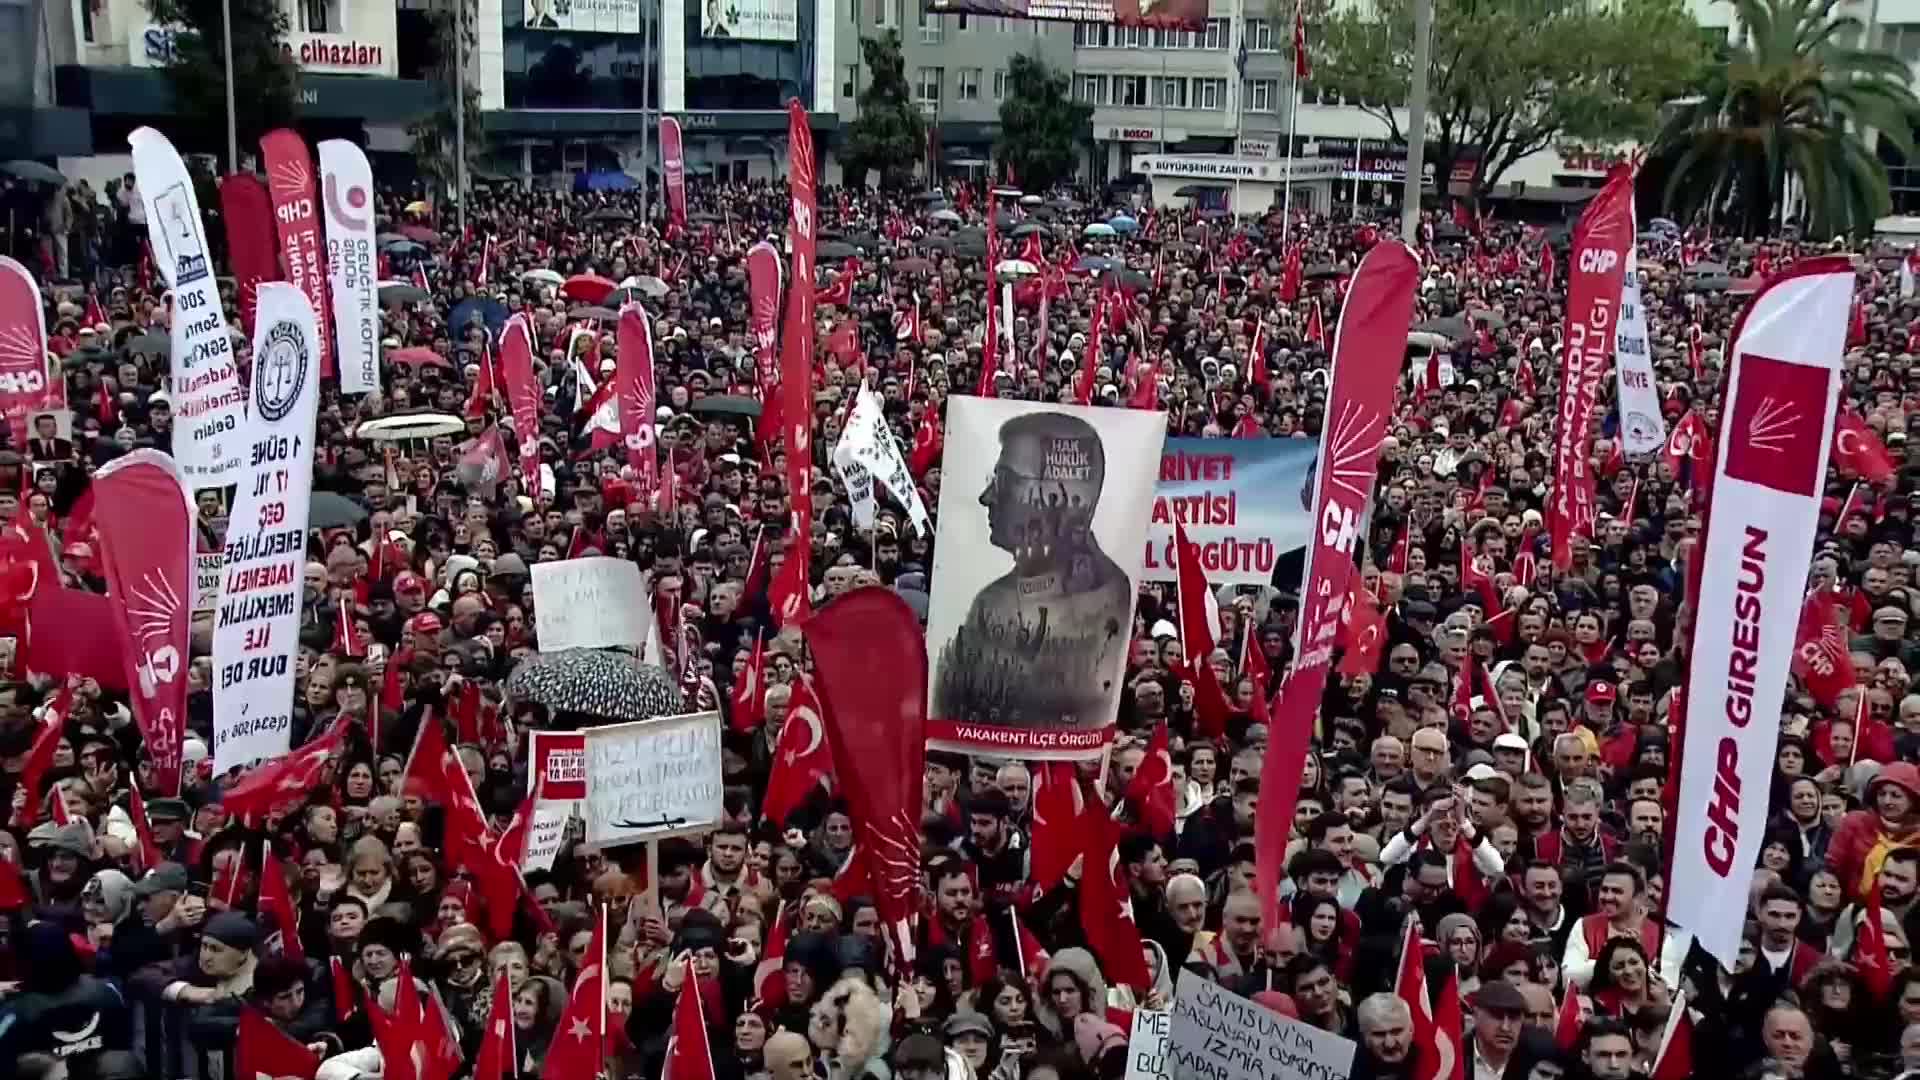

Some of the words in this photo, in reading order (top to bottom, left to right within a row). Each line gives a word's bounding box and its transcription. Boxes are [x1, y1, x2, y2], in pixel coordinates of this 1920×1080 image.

[1579, 247, 1617, 274] CHP
[1052, 438, 1080, 452] HAK
[1045, 452, 1089, 465] HUKUK
[1043, 465, 1091, 480] ADALET
[1726, 524, 1768, 729] GİRESUN
[1801, 639, 1835, 678] CHP
[956, 726, 1028, 745] YAKAKENT
[1029, 729, 1056, 748] İLÇE
[1703, 738, 1742, 878] CHP
